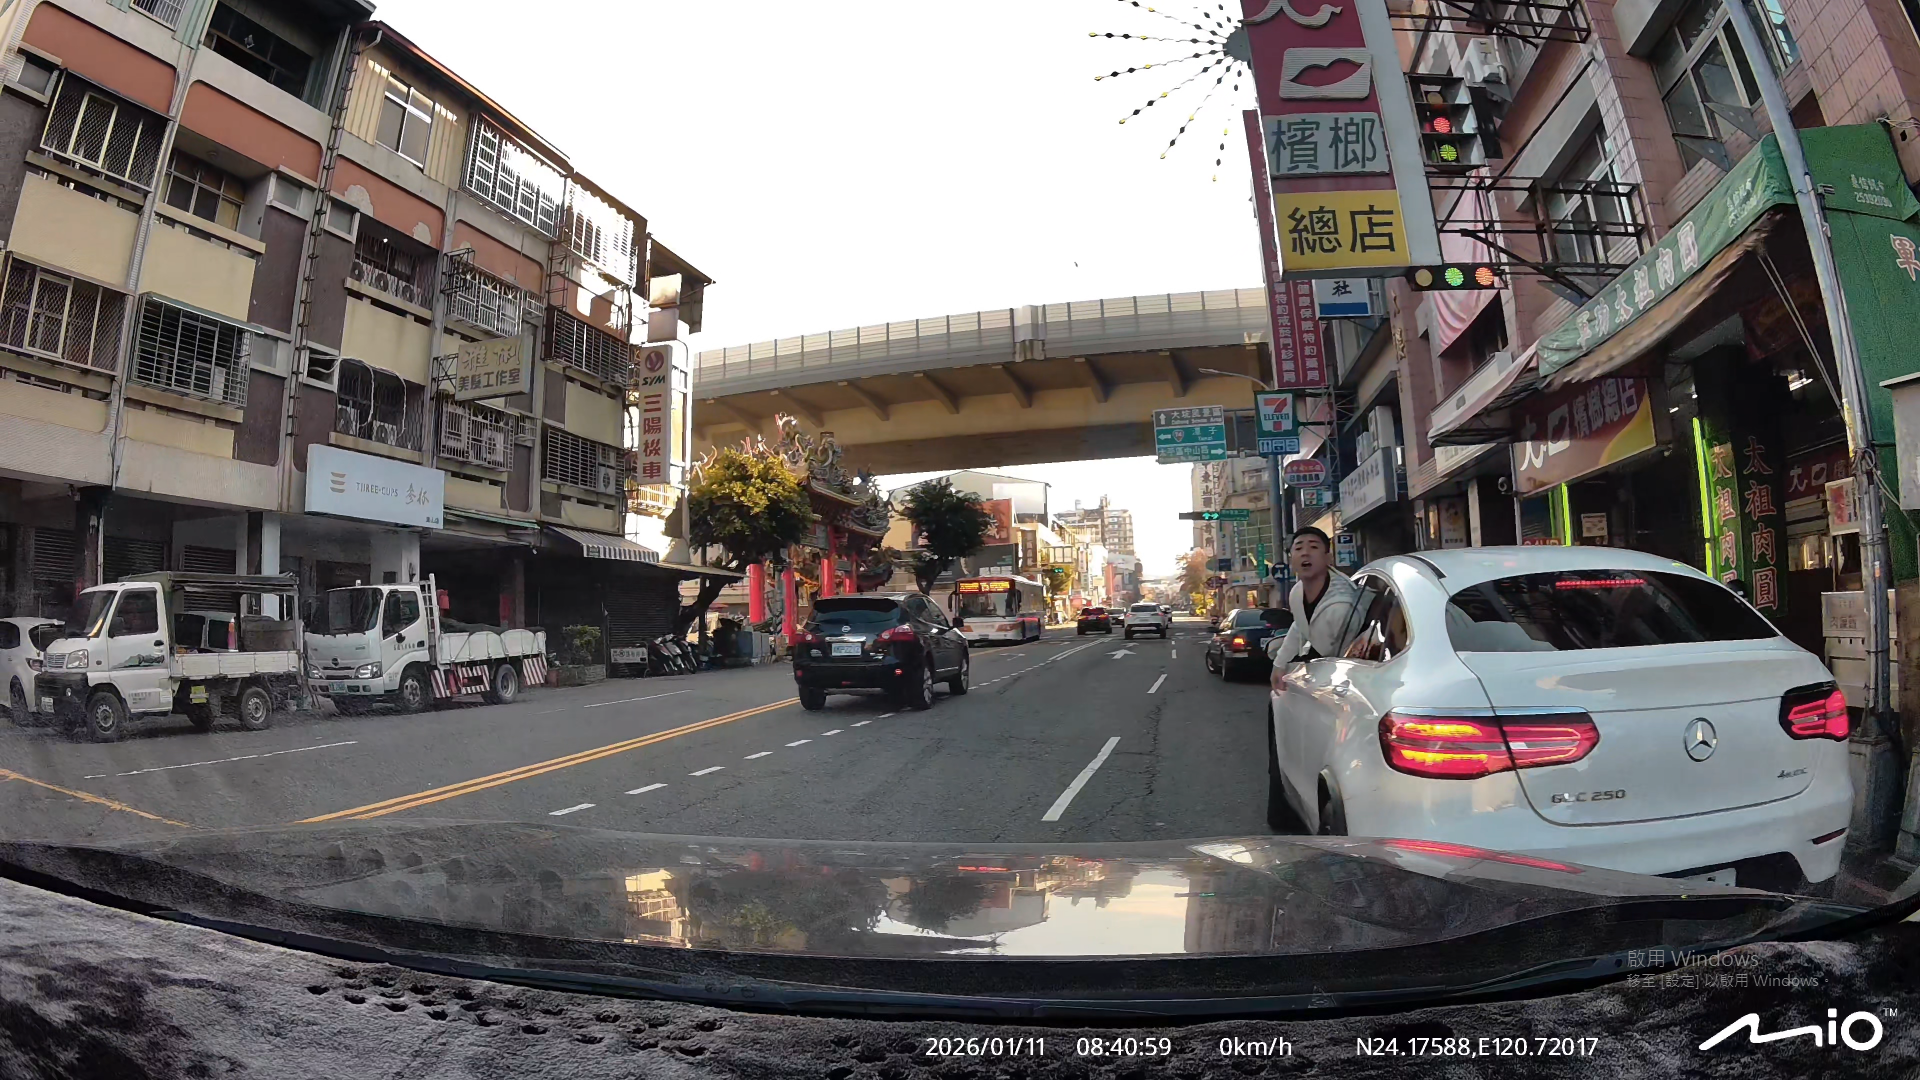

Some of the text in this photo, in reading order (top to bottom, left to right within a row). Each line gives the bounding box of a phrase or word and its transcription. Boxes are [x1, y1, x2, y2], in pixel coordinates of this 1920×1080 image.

[1271, 117, 1377, 172] 檳榔
[1287, 205, 1396, 256] 總店
[1332, 280, 1353, 298] 社
[1296, 279, 1320, 382] 健康保險特約藥局
[458, 367, 521, 393] 美髮工作室
[641, 375, 666, 386] SYM
[1171, 408, 1222, 419] 大坑風景區
[642, 393, 663, 479] 三陽機車
[1743, 436, 1780, 610] 太祖肉圓
[1340, 535, 1351, 544] P
[1551, 788, 1627, 804] GLC 250
